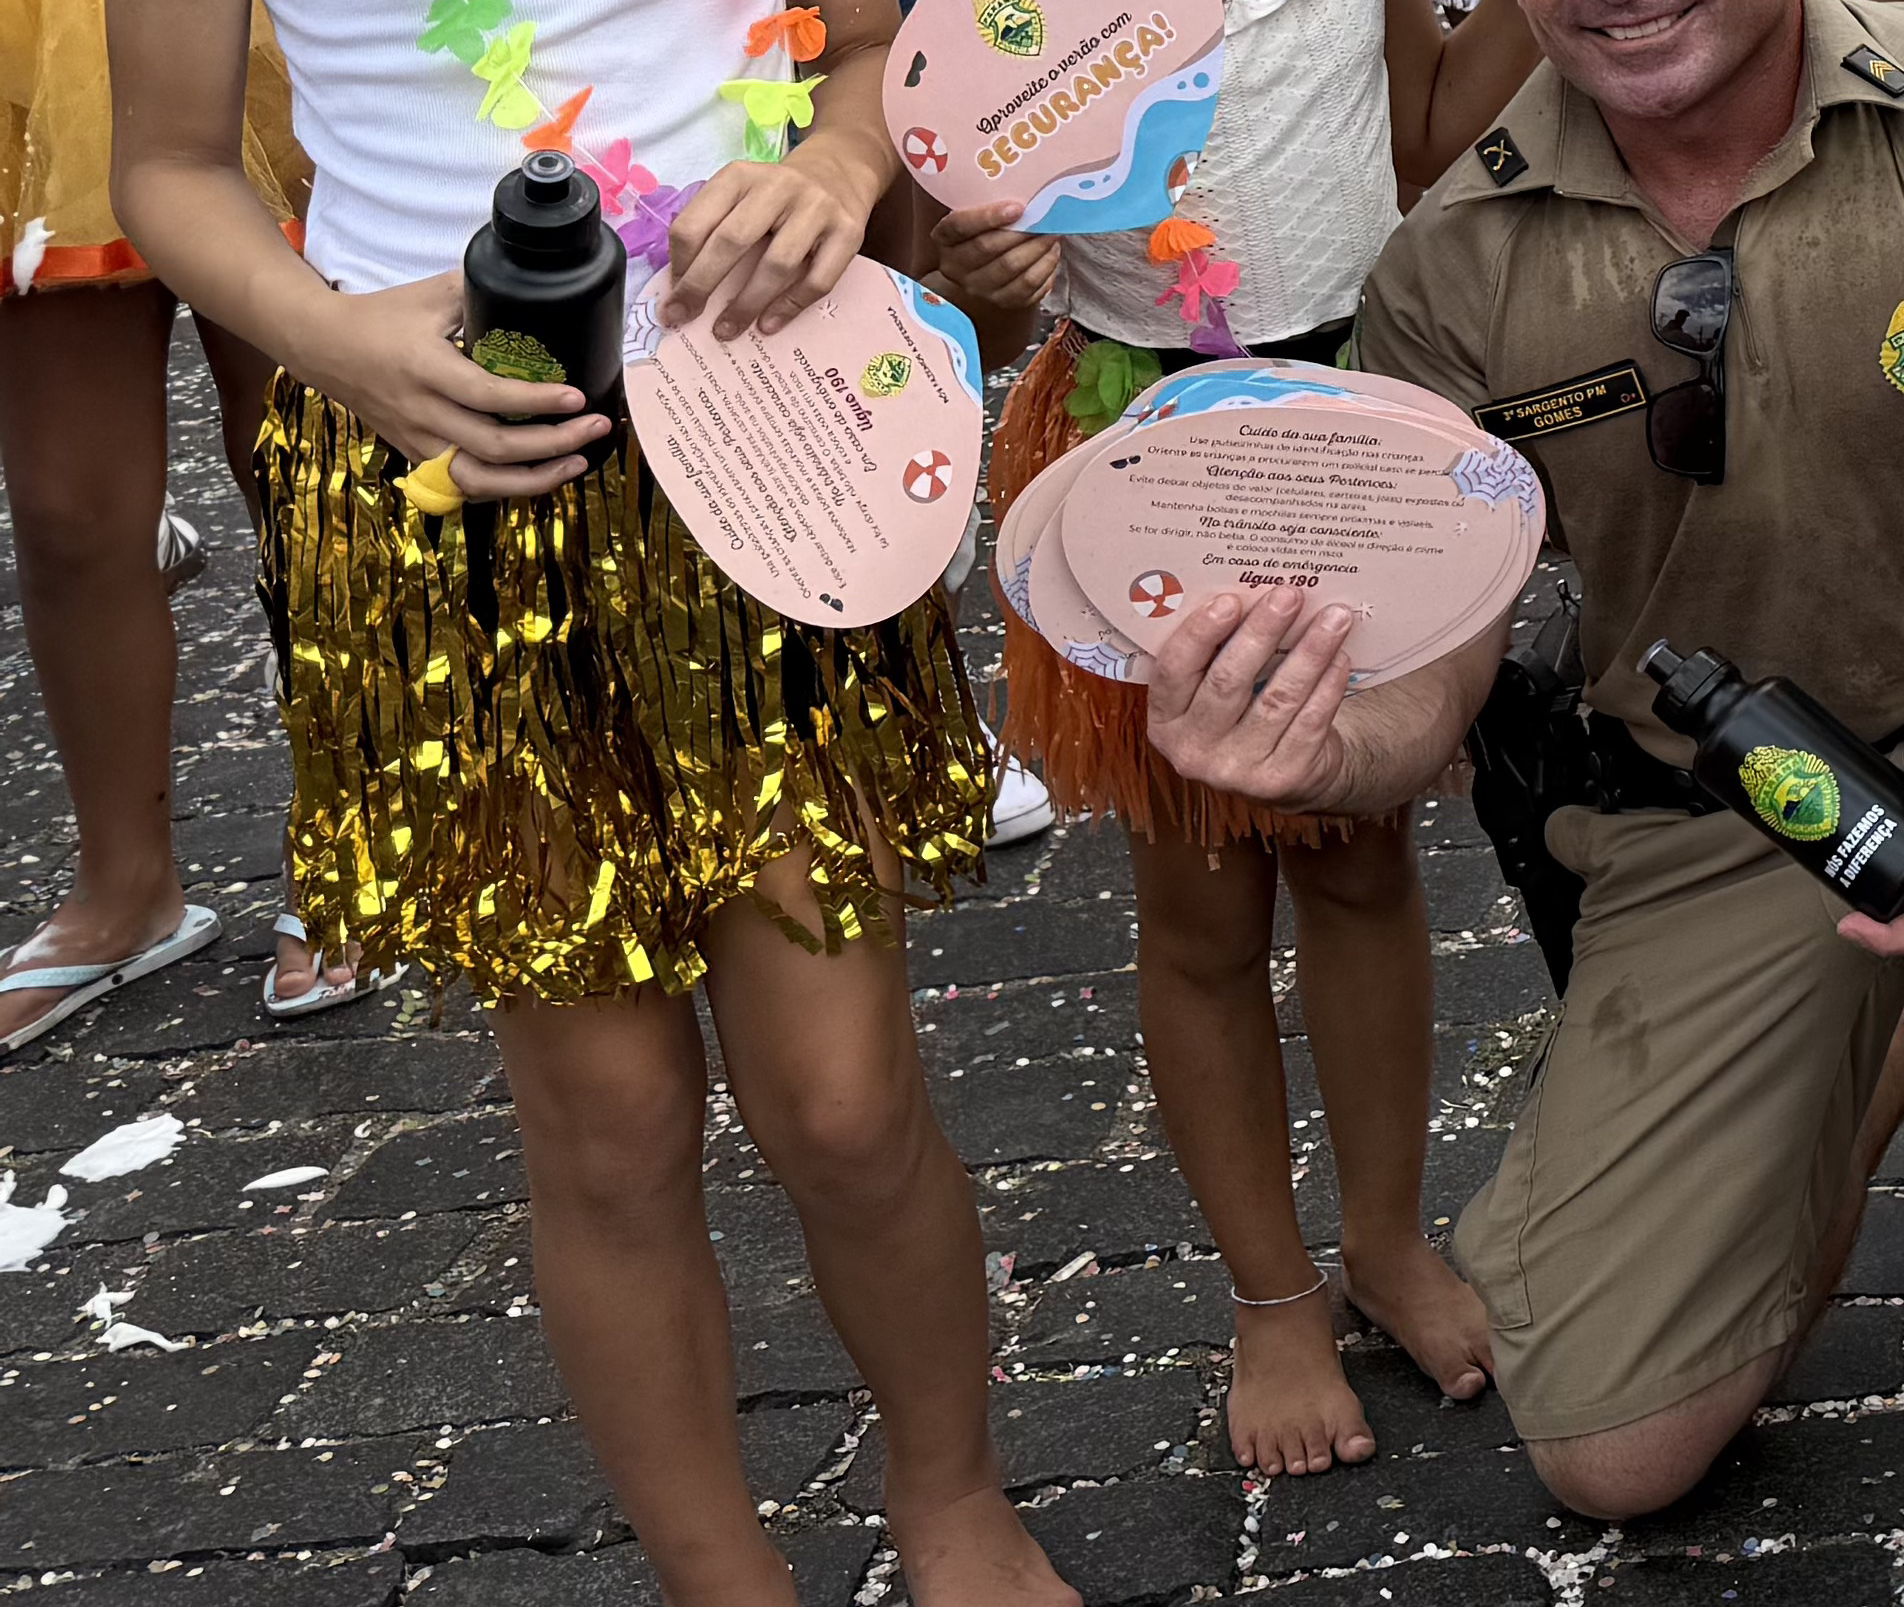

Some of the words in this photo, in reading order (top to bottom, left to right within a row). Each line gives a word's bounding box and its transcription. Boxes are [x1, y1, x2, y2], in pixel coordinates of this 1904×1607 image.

[976, 76, 1049, 135] Aproveite
[1048, 68, 1061, 82] o
[1057, 36, 1101, 73] verão
[1101, 11, 1133, 40] com
[976, 12, 1177, 178] SEGURANÇA!
[824, 367, 848, 393] 190
[1516, 392, 1585, 419] SARGENTO
[1586, 384, 1607, 399] PM
[1533, 406, 1584, 429] GOMES
[1288, 573, 1319, 588] 190
[1824, 854, 1845, 879] NÓS
[1836, 803, 1886, 859] FAZEMOS
[1844, 817, 1899, 881] DIFERENÇA
[1839, 876, 1852, 889] A
